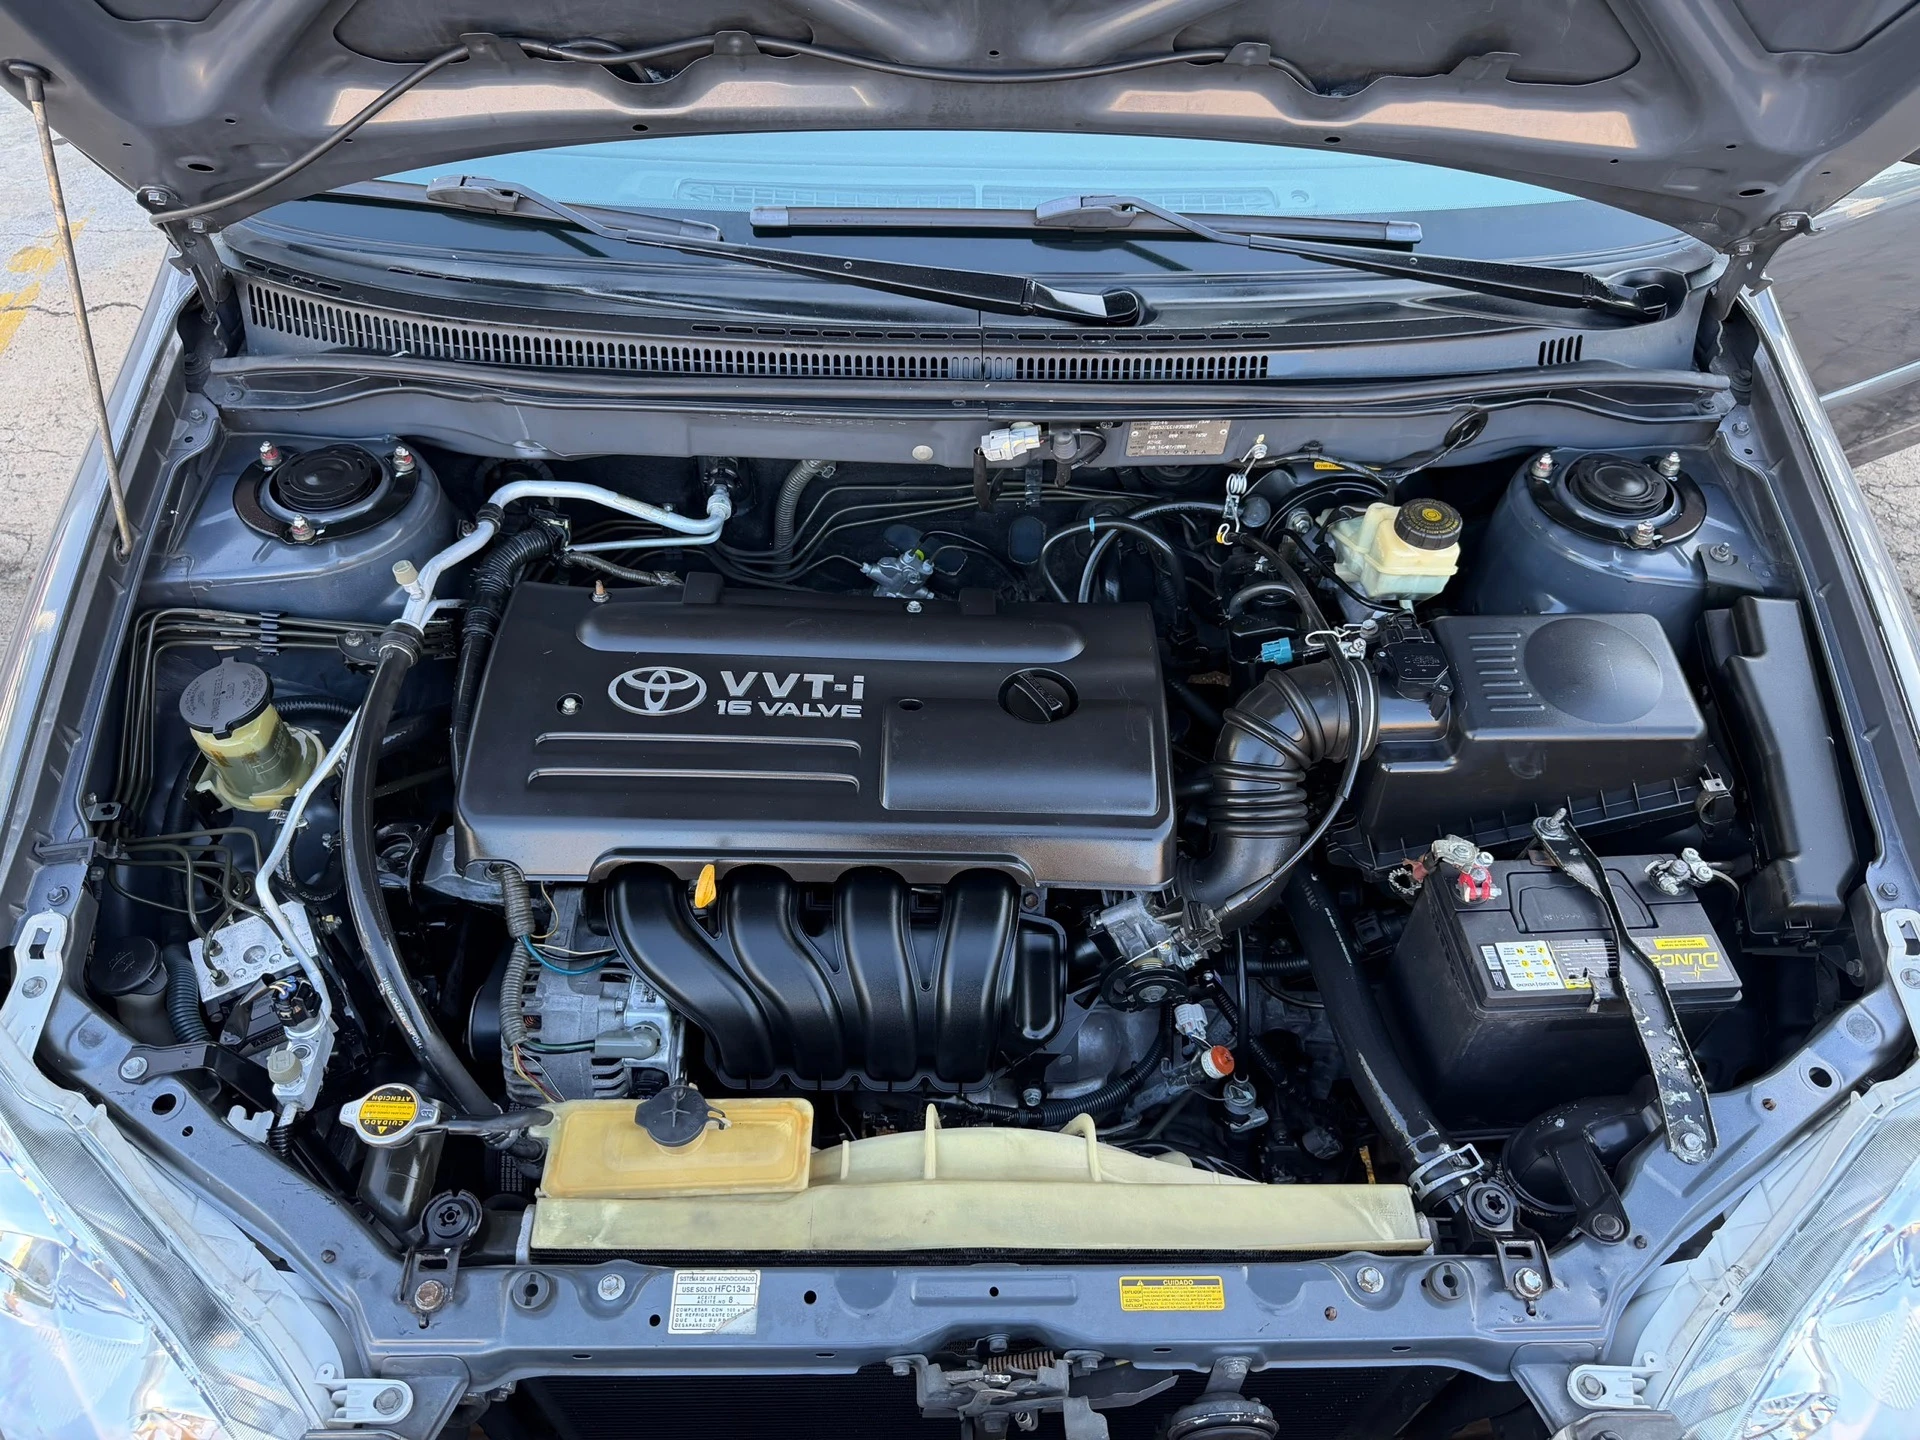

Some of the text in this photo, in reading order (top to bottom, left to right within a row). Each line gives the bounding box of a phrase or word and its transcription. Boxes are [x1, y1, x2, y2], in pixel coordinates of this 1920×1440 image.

[720, 671, 865, 700] VVT-i
[718, 700, 863, 718] 16 VALVE
[714, 1285, 751, 1293] HFC134a
[728, 1296, 734, 1304] 8
